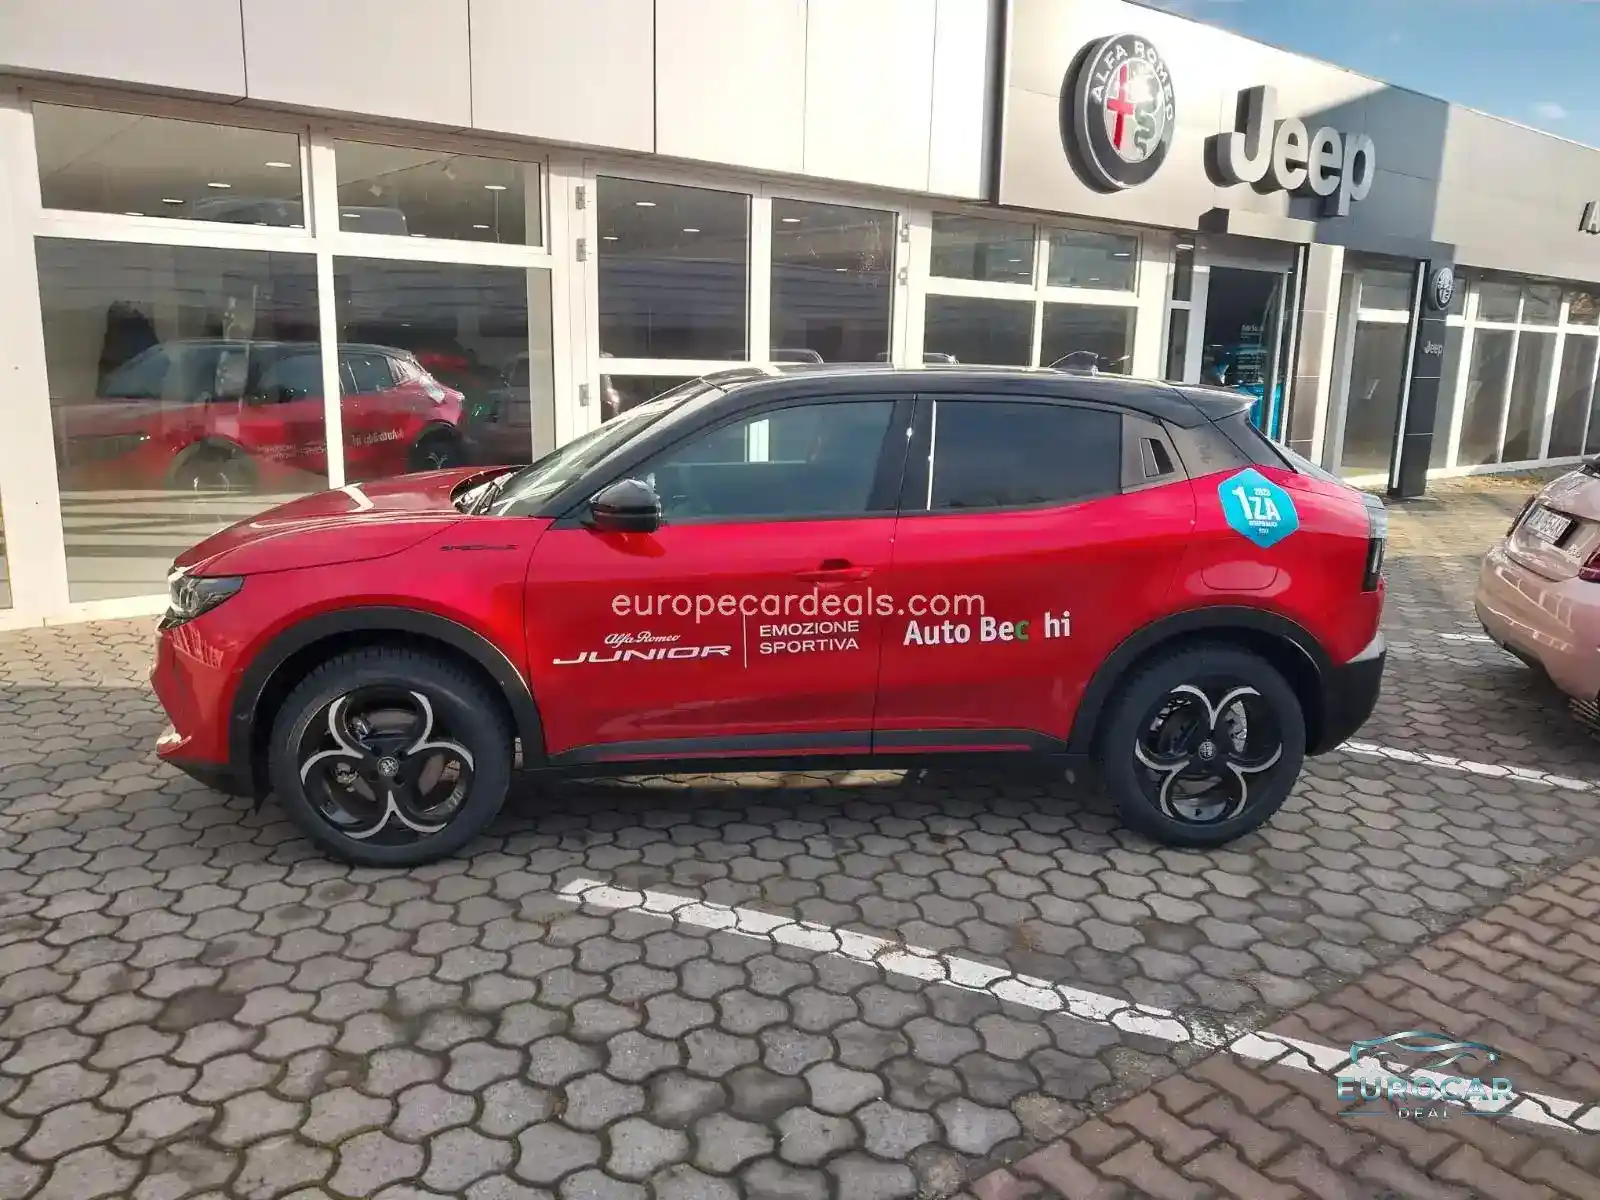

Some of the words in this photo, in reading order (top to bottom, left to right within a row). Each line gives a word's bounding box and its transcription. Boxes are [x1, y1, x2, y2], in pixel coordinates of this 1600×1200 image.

[1091, 43, 1129, 103] ALFA
[1133, 39, 1175, 122] ROMEO
[1226, 84, 1376, 217] Jeep
[1424, 340, 1444, 358] Jeep
[758, 619, 860, 637] EMOZIONE
[903, 619, 970, 647] Auto
[979, 610, 1071, 643] Bechi
[604, 632, 636, 649] Alfa
[636, 630, 681, 644] Romeo
[758, 638, 860, 656] SPORTIVA
[552, 644, 733, 665] JUNIOR
